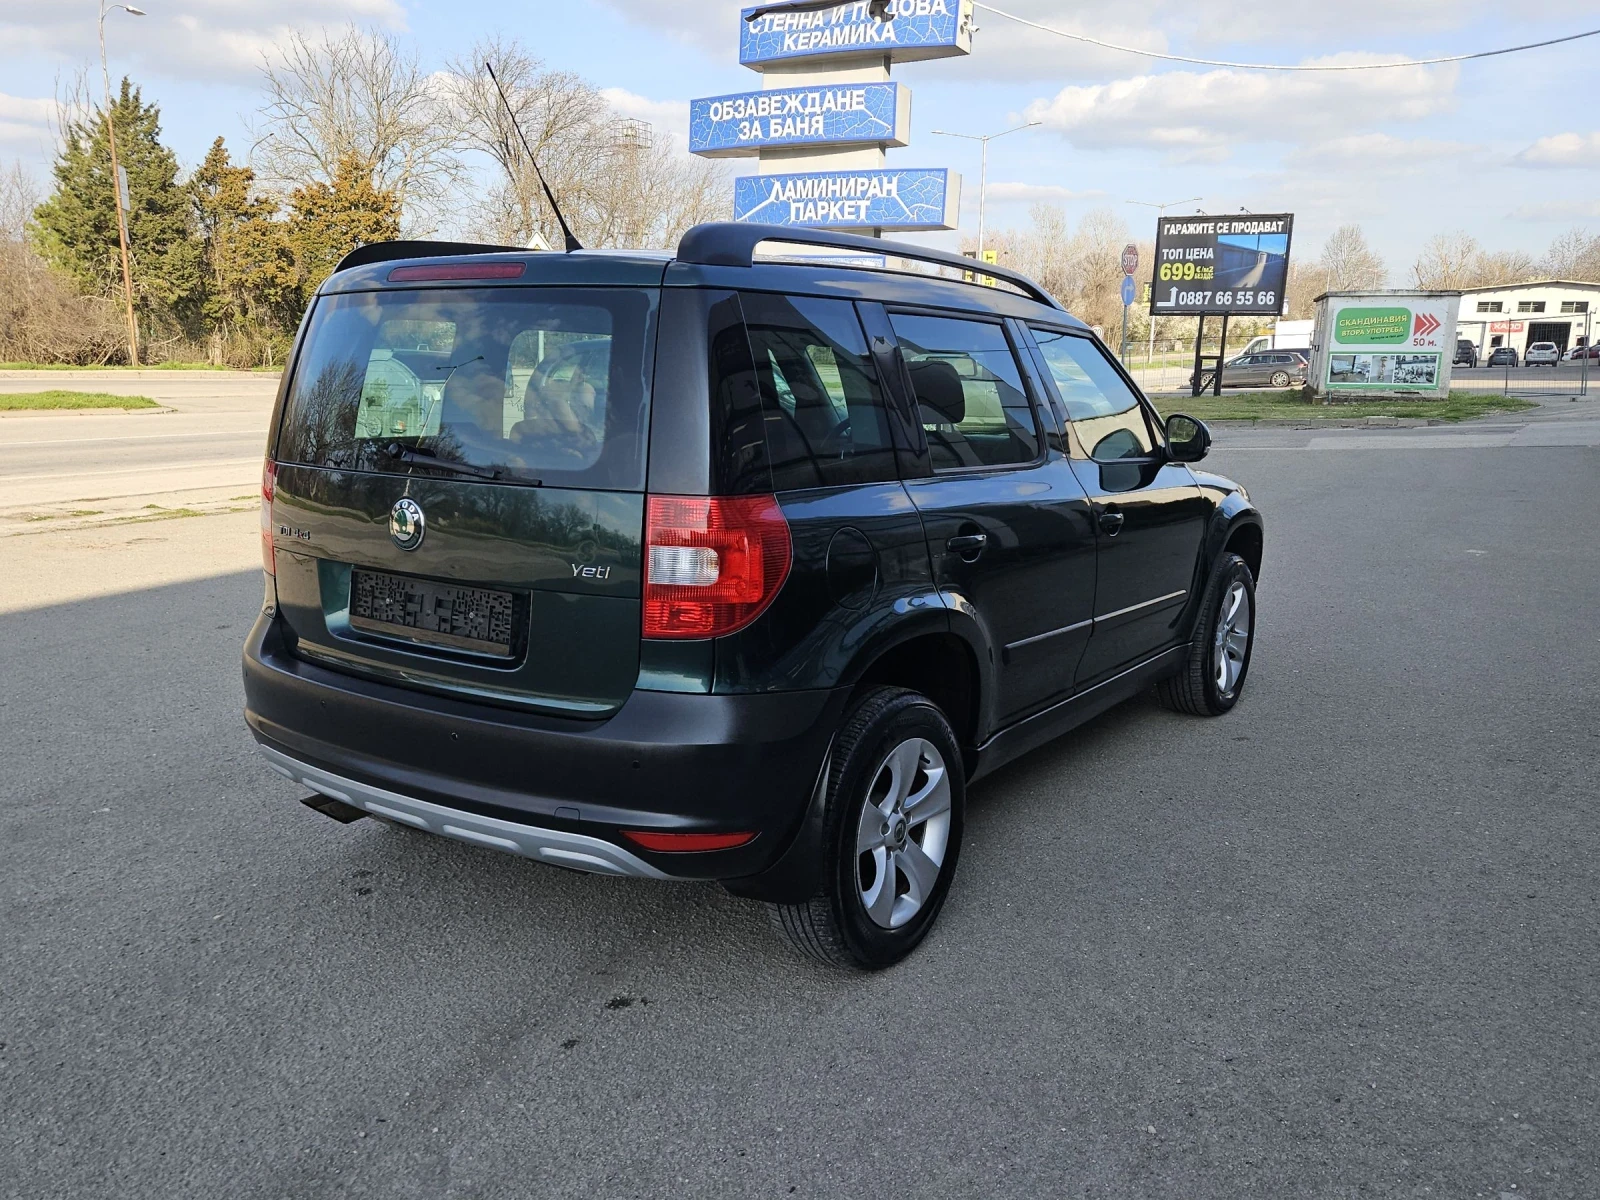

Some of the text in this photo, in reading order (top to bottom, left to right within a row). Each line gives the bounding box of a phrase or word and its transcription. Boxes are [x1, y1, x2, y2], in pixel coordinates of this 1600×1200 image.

[748, 0, 947, 34] СТЕННА И ПДОВА
[783, 21, 897, 51] КЕРАМИКА
[709, 89, 866, 121] ОБЗАВЕЖДАНЕ
[739, 115, 824, 140] ЗА БАНЯ
[770, 175, 898, 200] ЛАМИНИРАН
[789, 199, 871, 221] ПАРКЕТ
[1164, 221, 1284, 235] ГАРАЖИТЕ СЕ ПРОДАВАТ
[1124, 254, 1138, 266] STOP
[1162, 247, 1214, 260] ТОП ЦЕНА
[1160, 262, 1195, 281] 699
[1178, 290, 1275, 305] 0887 66 55 66
[1339, 314, 1407, 327] СКАНДИНАВИЯ
[1341, 328, 1365, 337] ВТОРА
[1366, 326, 1404, 335] УПОТРЕБА
[1413, 338, 1426, 346] 50
[571, 563, 611, 579] Yeti
